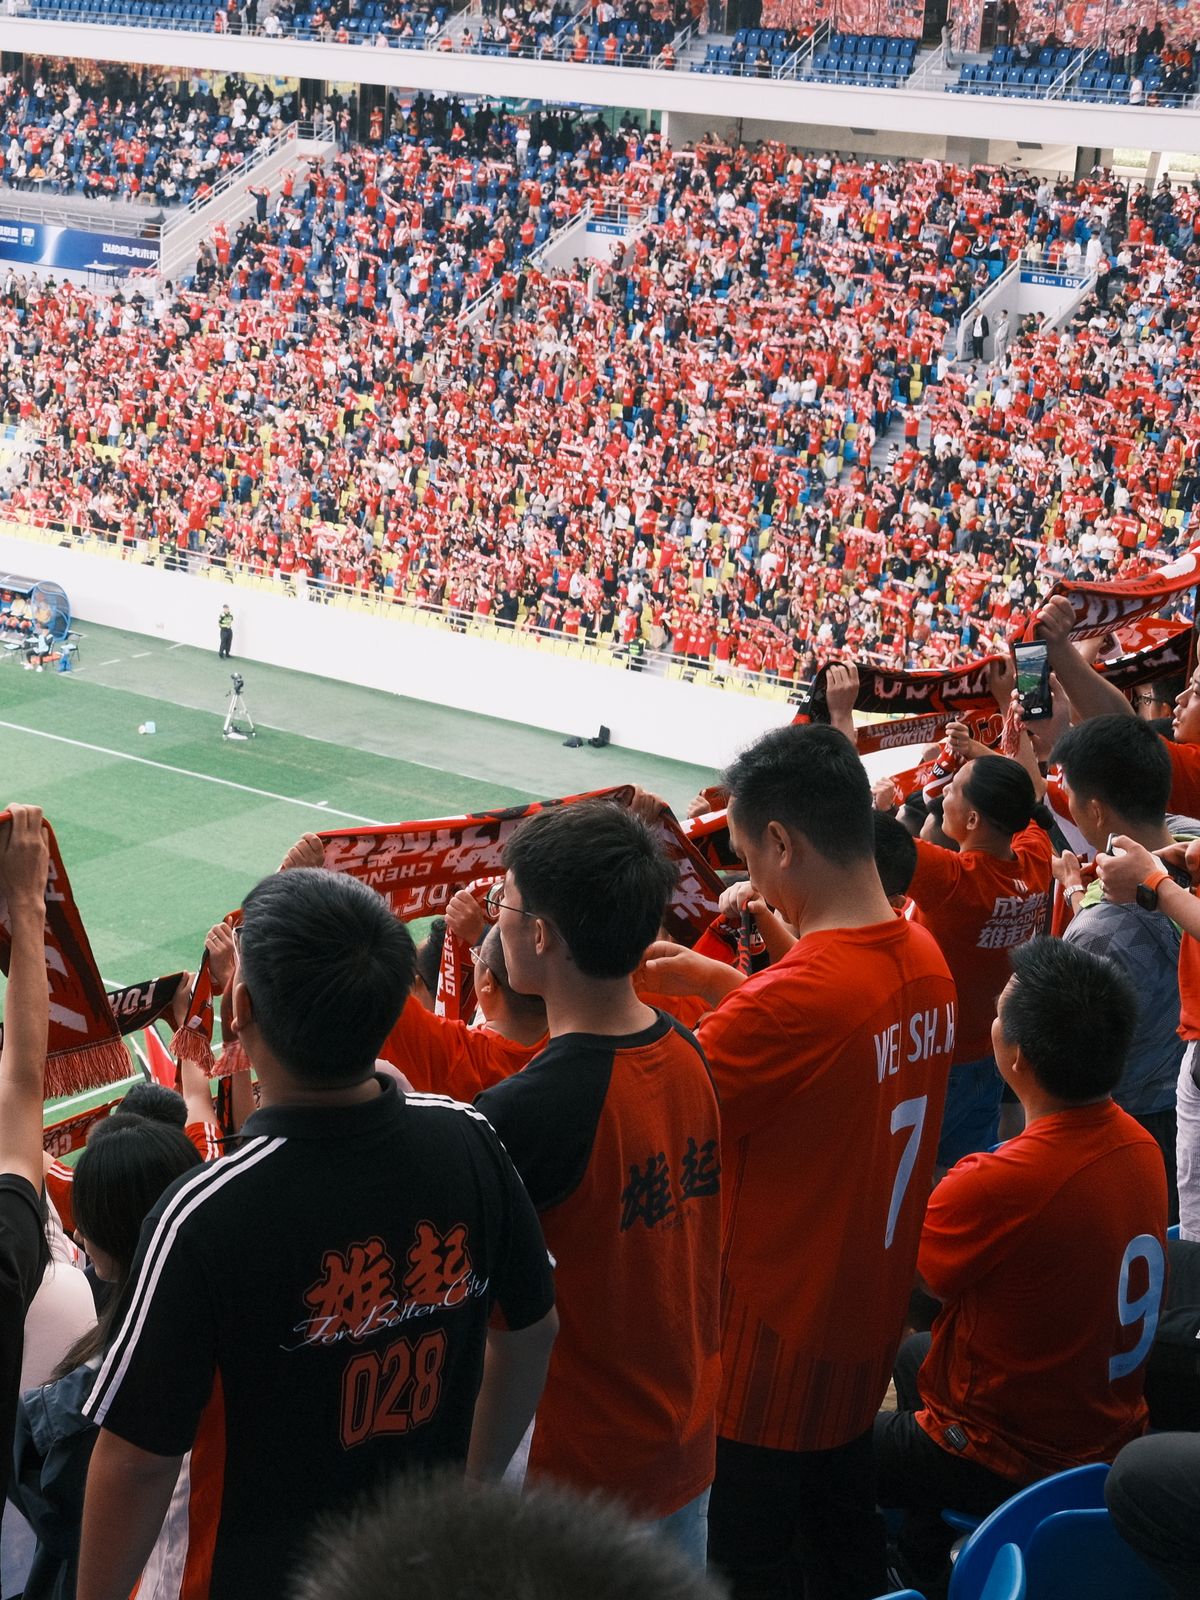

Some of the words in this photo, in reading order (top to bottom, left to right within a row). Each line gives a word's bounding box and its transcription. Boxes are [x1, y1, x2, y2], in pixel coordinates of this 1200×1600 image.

[986, 910, 1037, 926] CHENGDU
[619, 1136, 721, 1232] 雄起
[884, 1095, 928, 1250] 7
[280, 1313, 354, 1351] For
[354, 1300, 442, 1336] Better
[443, 1270, 490, 1307] City
[302, 1219, 474, 1344] 雄起
[1108, 1233, 1166, 1382] 9
[340, 1328, 447, 1451] 028
